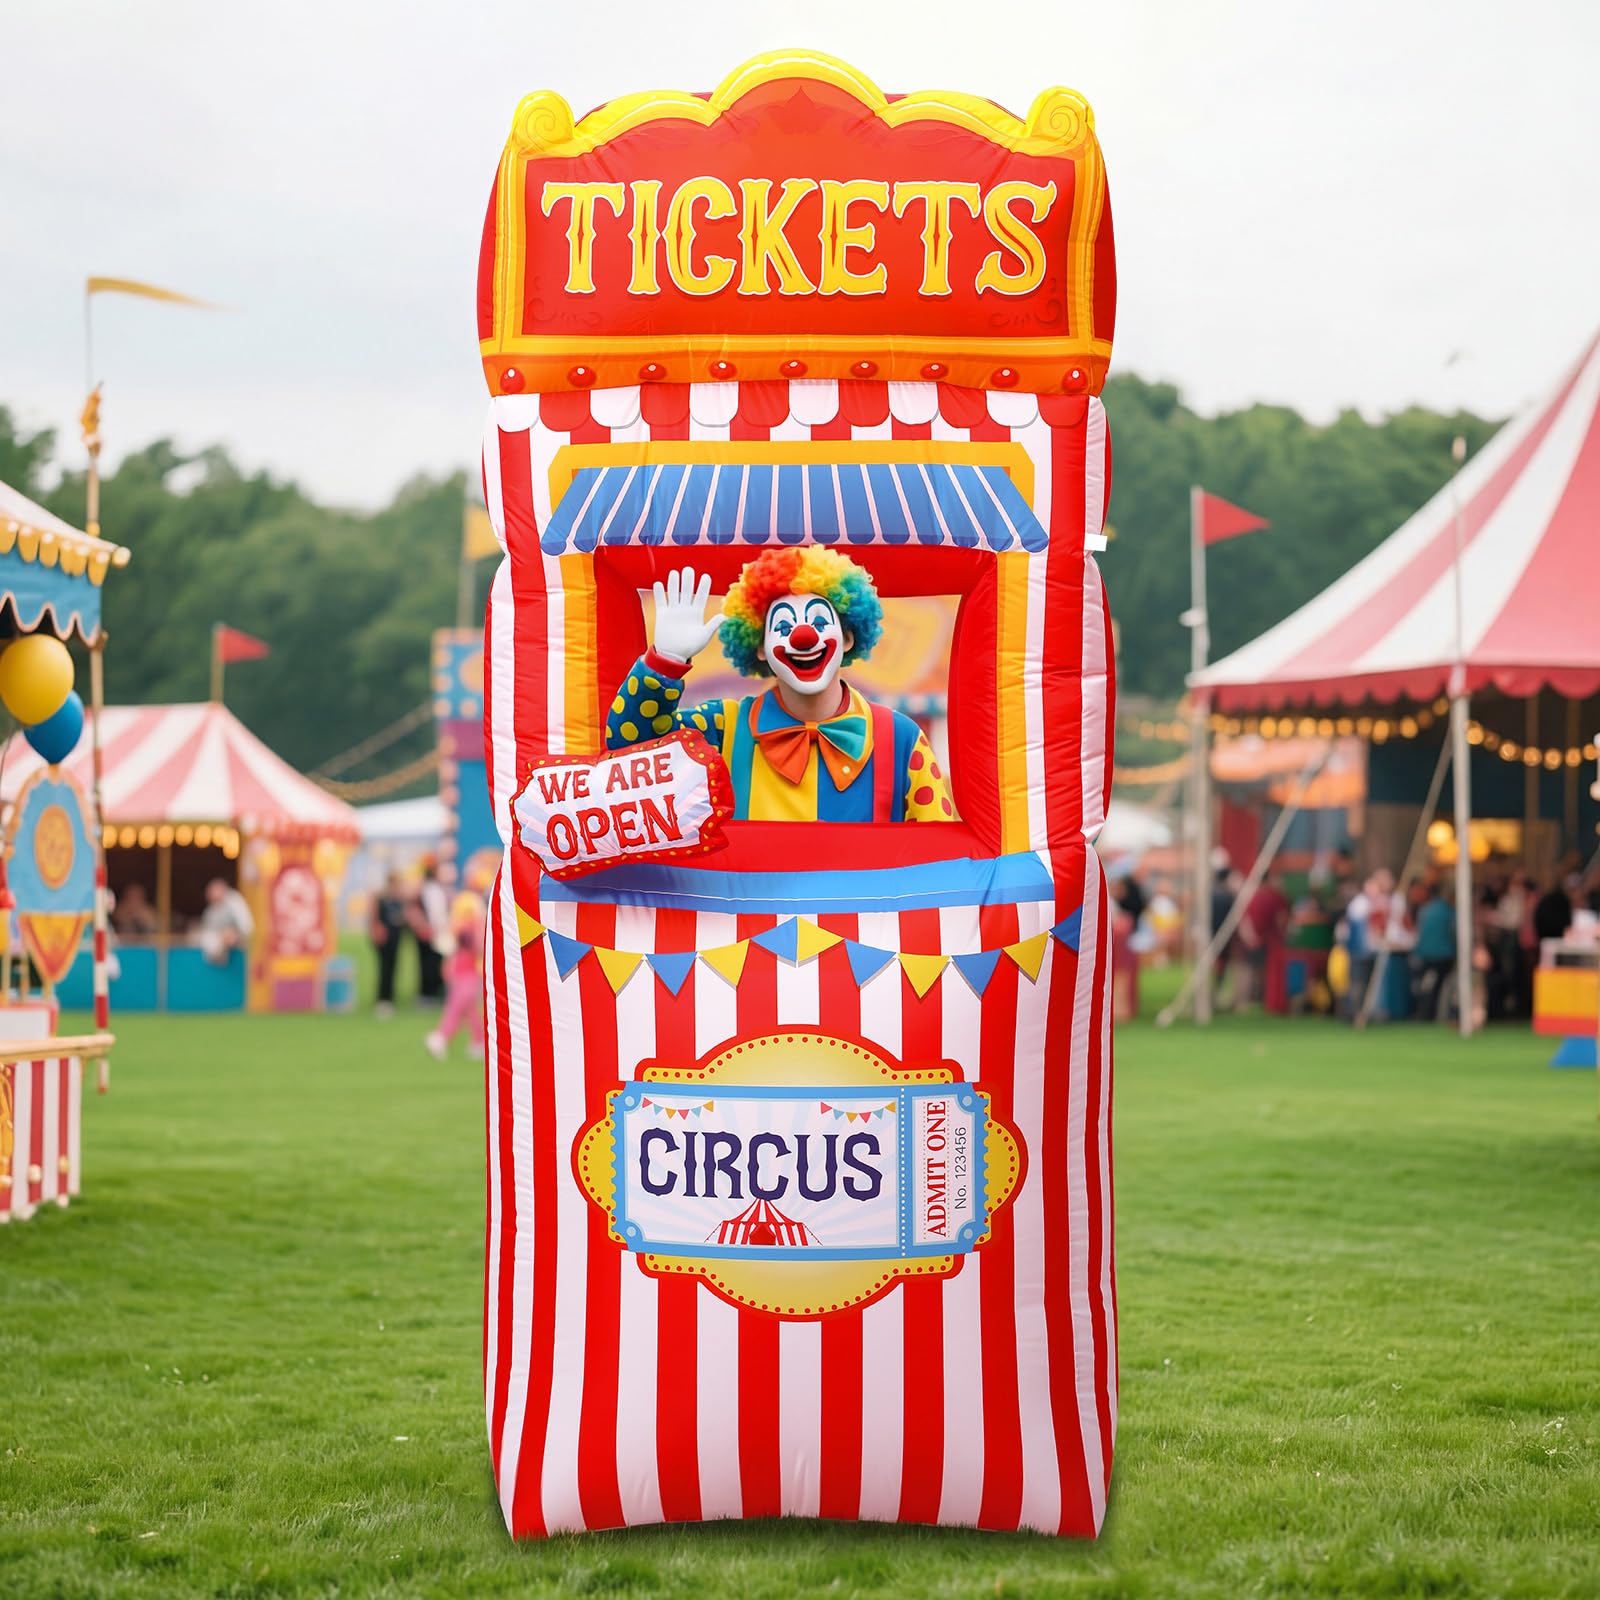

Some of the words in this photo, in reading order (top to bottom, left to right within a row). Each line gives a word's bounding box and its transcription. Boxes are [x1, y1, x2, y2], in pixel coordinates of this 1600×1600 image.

[541, 176, 1057, 296] TICKETS
[538, 770, 590, 804] WE
[606, 753, 673, 793] ARE
[547, 795, 683, 860] OPEN
[926, 1101, 946, 1151] ONE
[955, 1127, 967, 1178] 123456
[639, 1127, 883, 1202] CIRCUS
[926, 1158, 947, 1237] ADMIT
[955, 1185, 966, 1209] No.
